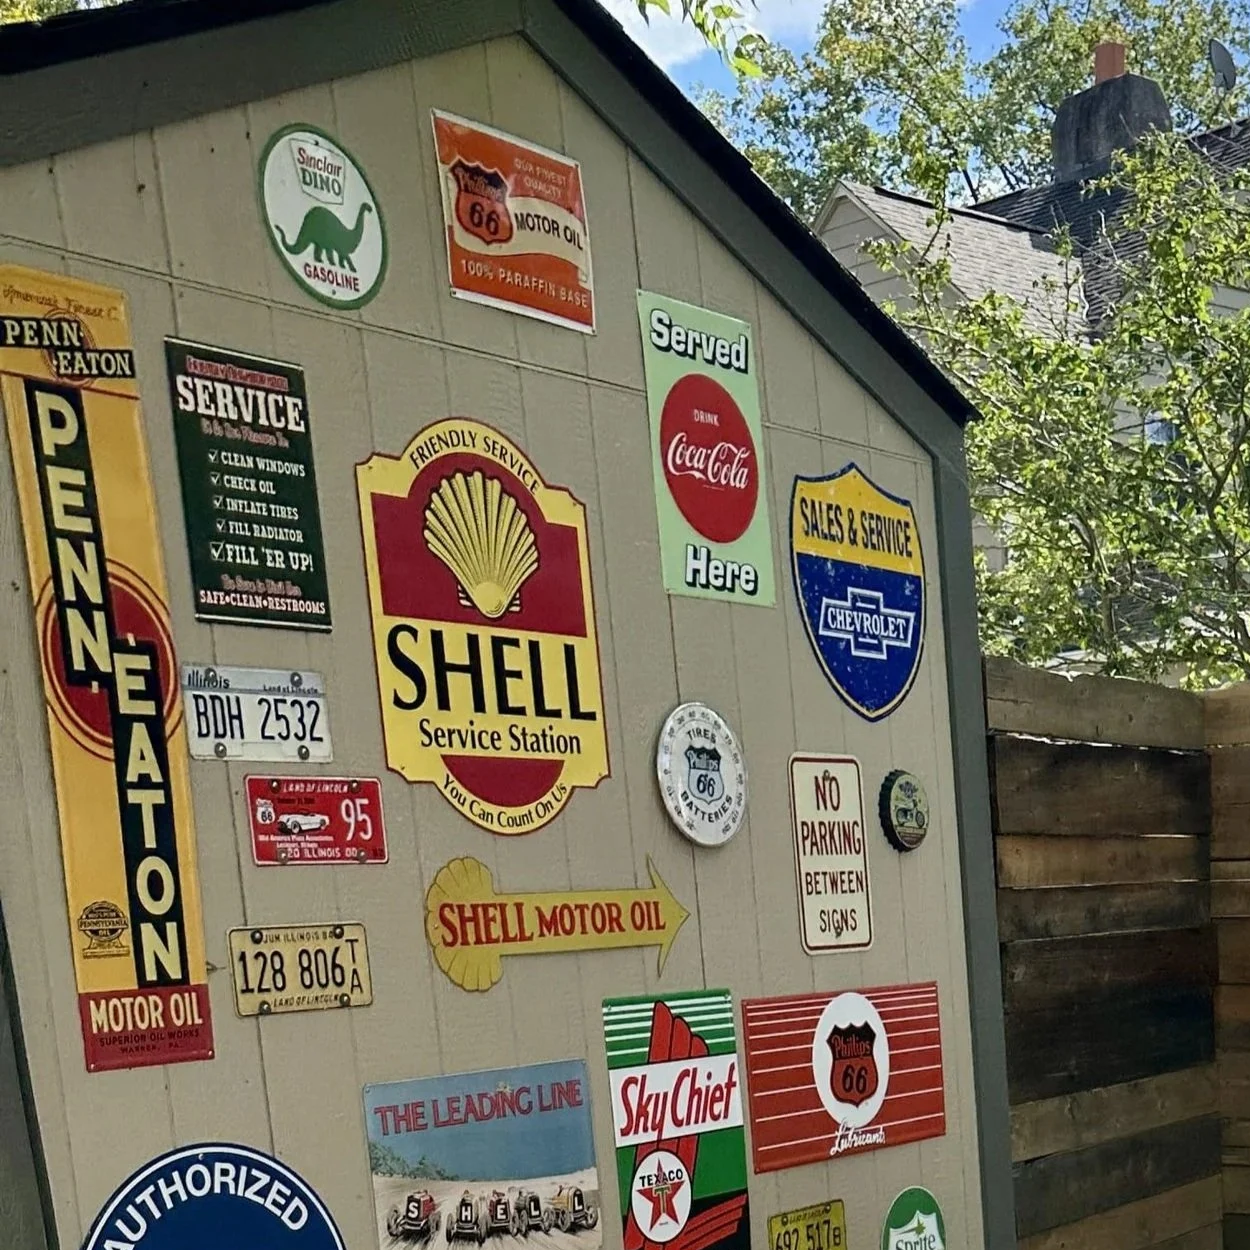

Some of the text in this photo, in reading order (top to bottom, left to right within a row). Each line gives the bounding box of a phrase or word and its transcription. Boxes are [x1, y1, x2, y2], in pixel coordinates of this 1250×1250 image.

[297, 147, 342, 176] Sinclair
[301, 169, 342, 197] DINO
[470, 202, 500, 236] 66
[514, 212, 583, 250] MOTOR OIL
[303, 262, 360, 292] GASOLINE
[461, 259, 588, 309] 100% PARAFFIN BASE
[4, 320, 81, 347] PENN
[650, 309, 749, 374] Served
[57, 351, 132, 376] EATON
[176, 374, 306, 432] SERVICE
[693, 408, 720, 427] DRINK
[221, 451, 306, 477] CLEAN WINDOWS
[409, 429, 540, 494] FRIENDLY SERVICE
[667, 432, 750, 490] Coca-Cola
[224, 475, 276, 495] CHECK OIL
[226, 498, 299, 520] INFLATE TIRES
[35, 390, 113, 673] PENN
[228, 521, 304, 543] FILL RADIATOR
[800, 496, 913, 558] SALES & SERVICE
[225, 544, 314, 572] FILL 'ER UP!
[685, 543, 759, 596] Here
[200, 590, 326, 614] SAFE CLEAN RESTROOMS
[827, 607, 907, 639] CHEVROLET
[187, 669, 230, 689] Illinois
[387, 623, 597, 721] SHELL
[192, 693, 323, 742] BDH 2532
[419, 718, 582, 754] Service Station
[685, 727, 716, 744] TIRES
[283, 782, 349, 793] LAND OF LINCOLN
[443, 772, 568, 829] You Can Count On Us
[697, 774, 716, 797] 66
[814, 775, 840, 811] NO
[113, 653, 182, 982] EATON
[261, 810, 273, 822] 66
[341, 798, 373, 841] 95
[681, 790, 733, 823] BATTERIES
[287, 848, 300, 858] 20
[303, 847, 341, 858] ILLINOIS
[801, 821, 861, 856] PARKING
[805, 870, 864, 895] BETWEEN
[439, 901, 666, 948] SHELL MOTOR OIL
[820, 908, 857, 933] SIGNS
[283, 932, 319, 944] ILLINOIS
[238, 946, 345, 994] 128 806
[90, 992, 203, 1034] MOTOR OIL
[273, 998, 294, 1007] LAND
[100, 1029, 199, 1047] SUPERIOR OIL WORKS
[831, 1034, 871, 1059] Phillips
[842, 1065, 868, 1094] 66
[374, 1079, 583, 1136] THE LEADING LINE
[620, 1062, 736, 1143] Sky Chief
[639, 1168, 684, 1188] TEXACO
